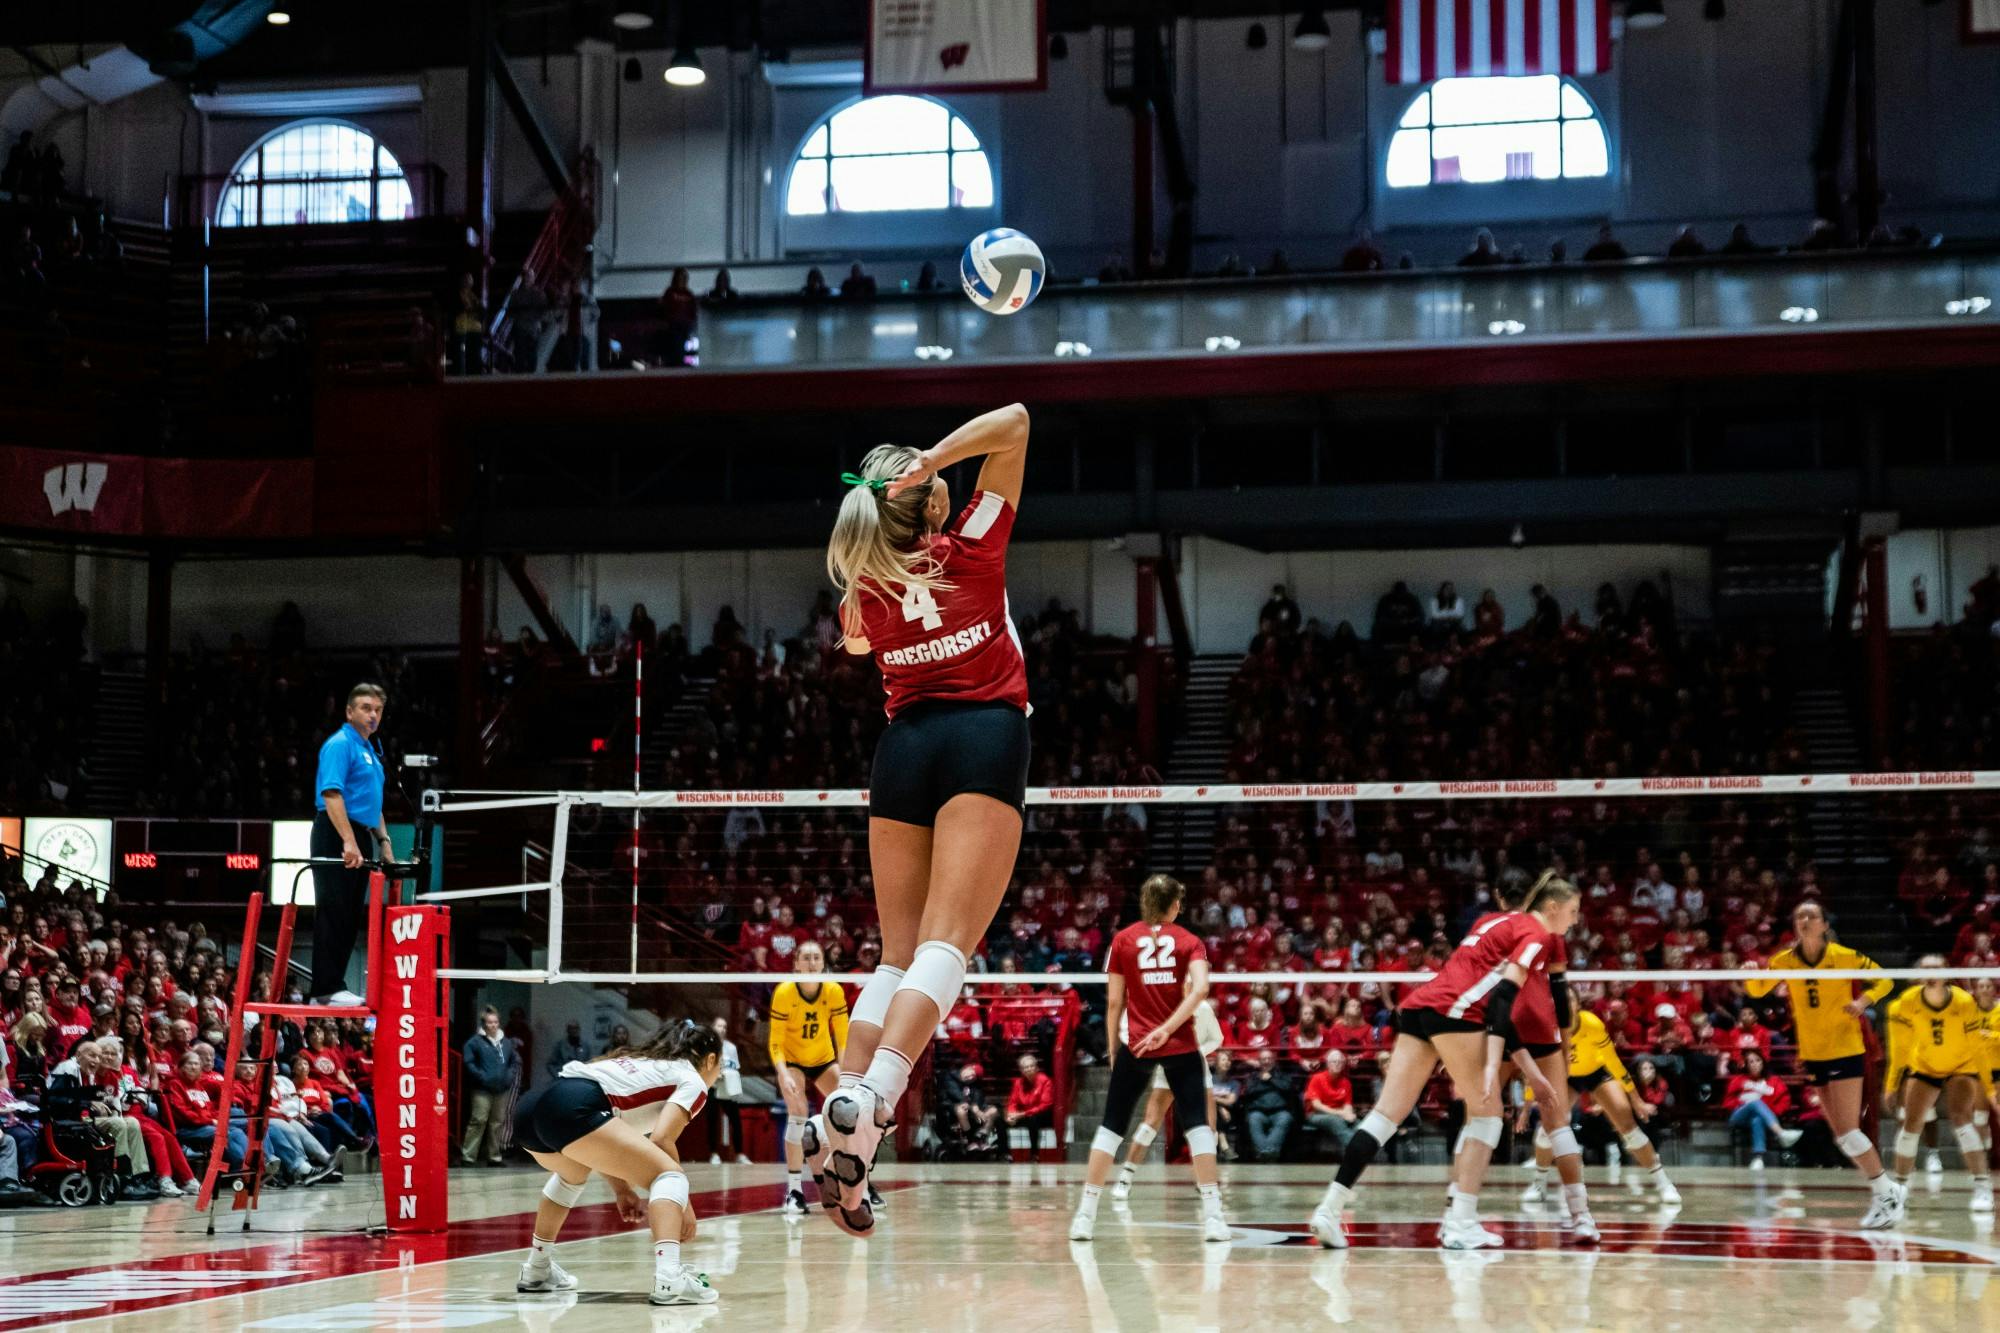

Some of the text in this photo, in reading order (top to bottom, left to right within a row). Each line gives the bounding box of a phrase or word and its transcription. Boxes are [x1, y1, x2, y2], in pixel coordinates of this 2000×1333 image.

[43, 462, 108, 517] W
[902, 579, 943, 632] 4
[883, 621, 992, 666] GREGORSKI
[1050, 787, 1162, 799] WISCONSIN BADGERS
[1241, 784, 1358, 797] WISCONSIN BADGERS
[1439, 780, 1558, 793] WISCONSIN BADGERS
[1641, 777, 1763, 790] WISCONSIN BADGERS
[676, 792, 785, 803] WISCONSIN BADGERS
[124, 853, 157, 869] WISC
[391, 913, 423, 945] W
[1136, 934, 1176, 970] 22
[394, 955, 418, 1220] WISCONSIN
